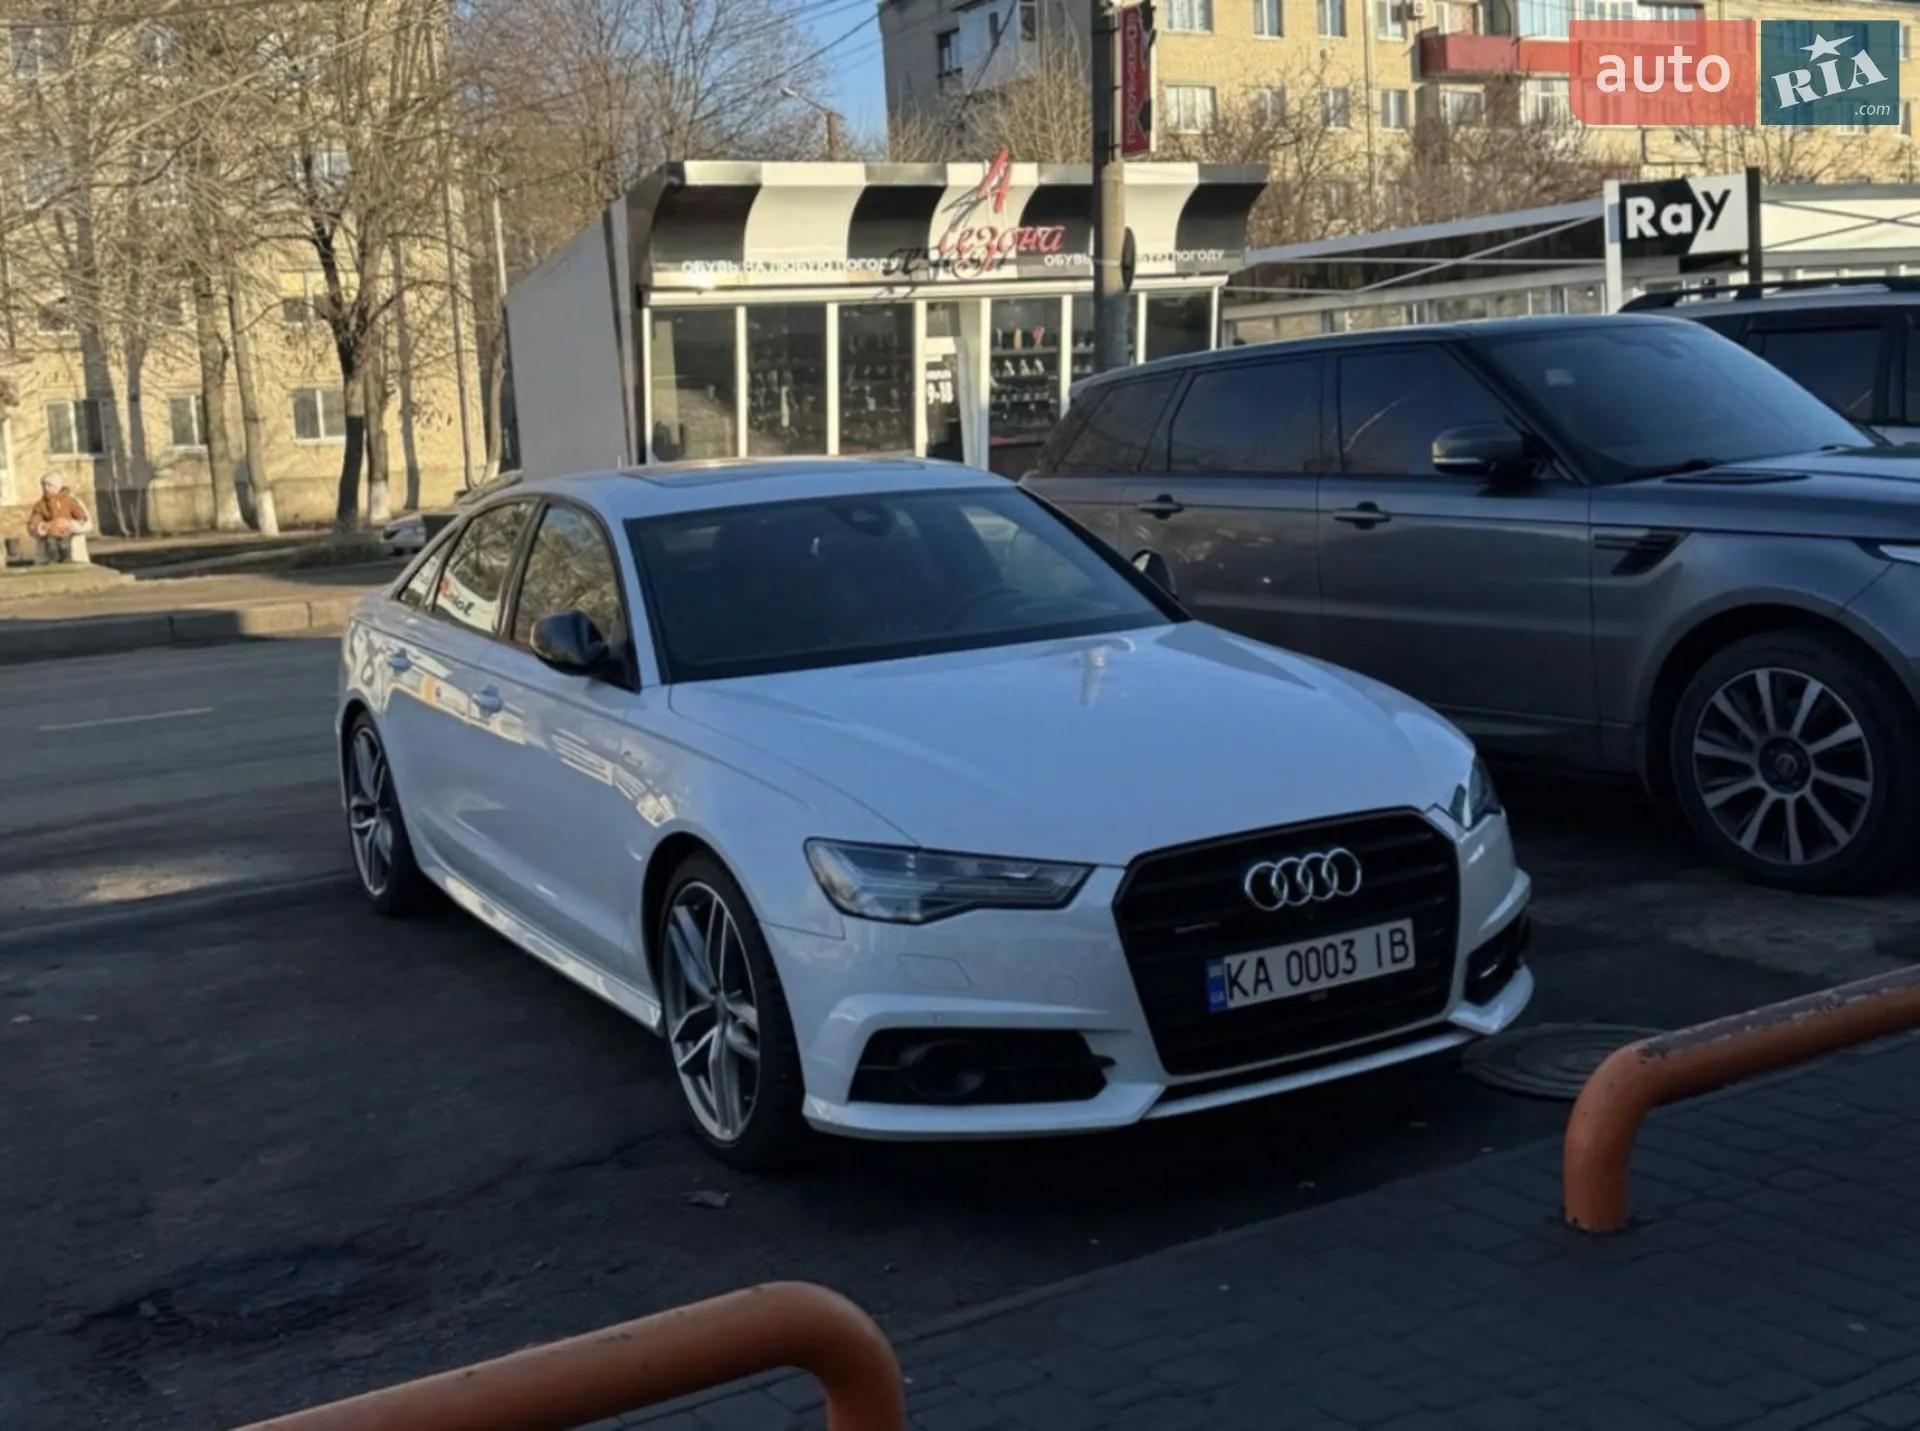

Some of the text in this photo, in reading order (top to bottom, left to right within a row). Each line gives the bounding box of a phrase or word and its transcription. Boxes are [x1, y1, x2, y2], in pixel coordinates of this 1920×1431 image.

[1625, 188, 1732, 240] Ray
[1225, 927, 1410, 1000] KA 0003 IB
